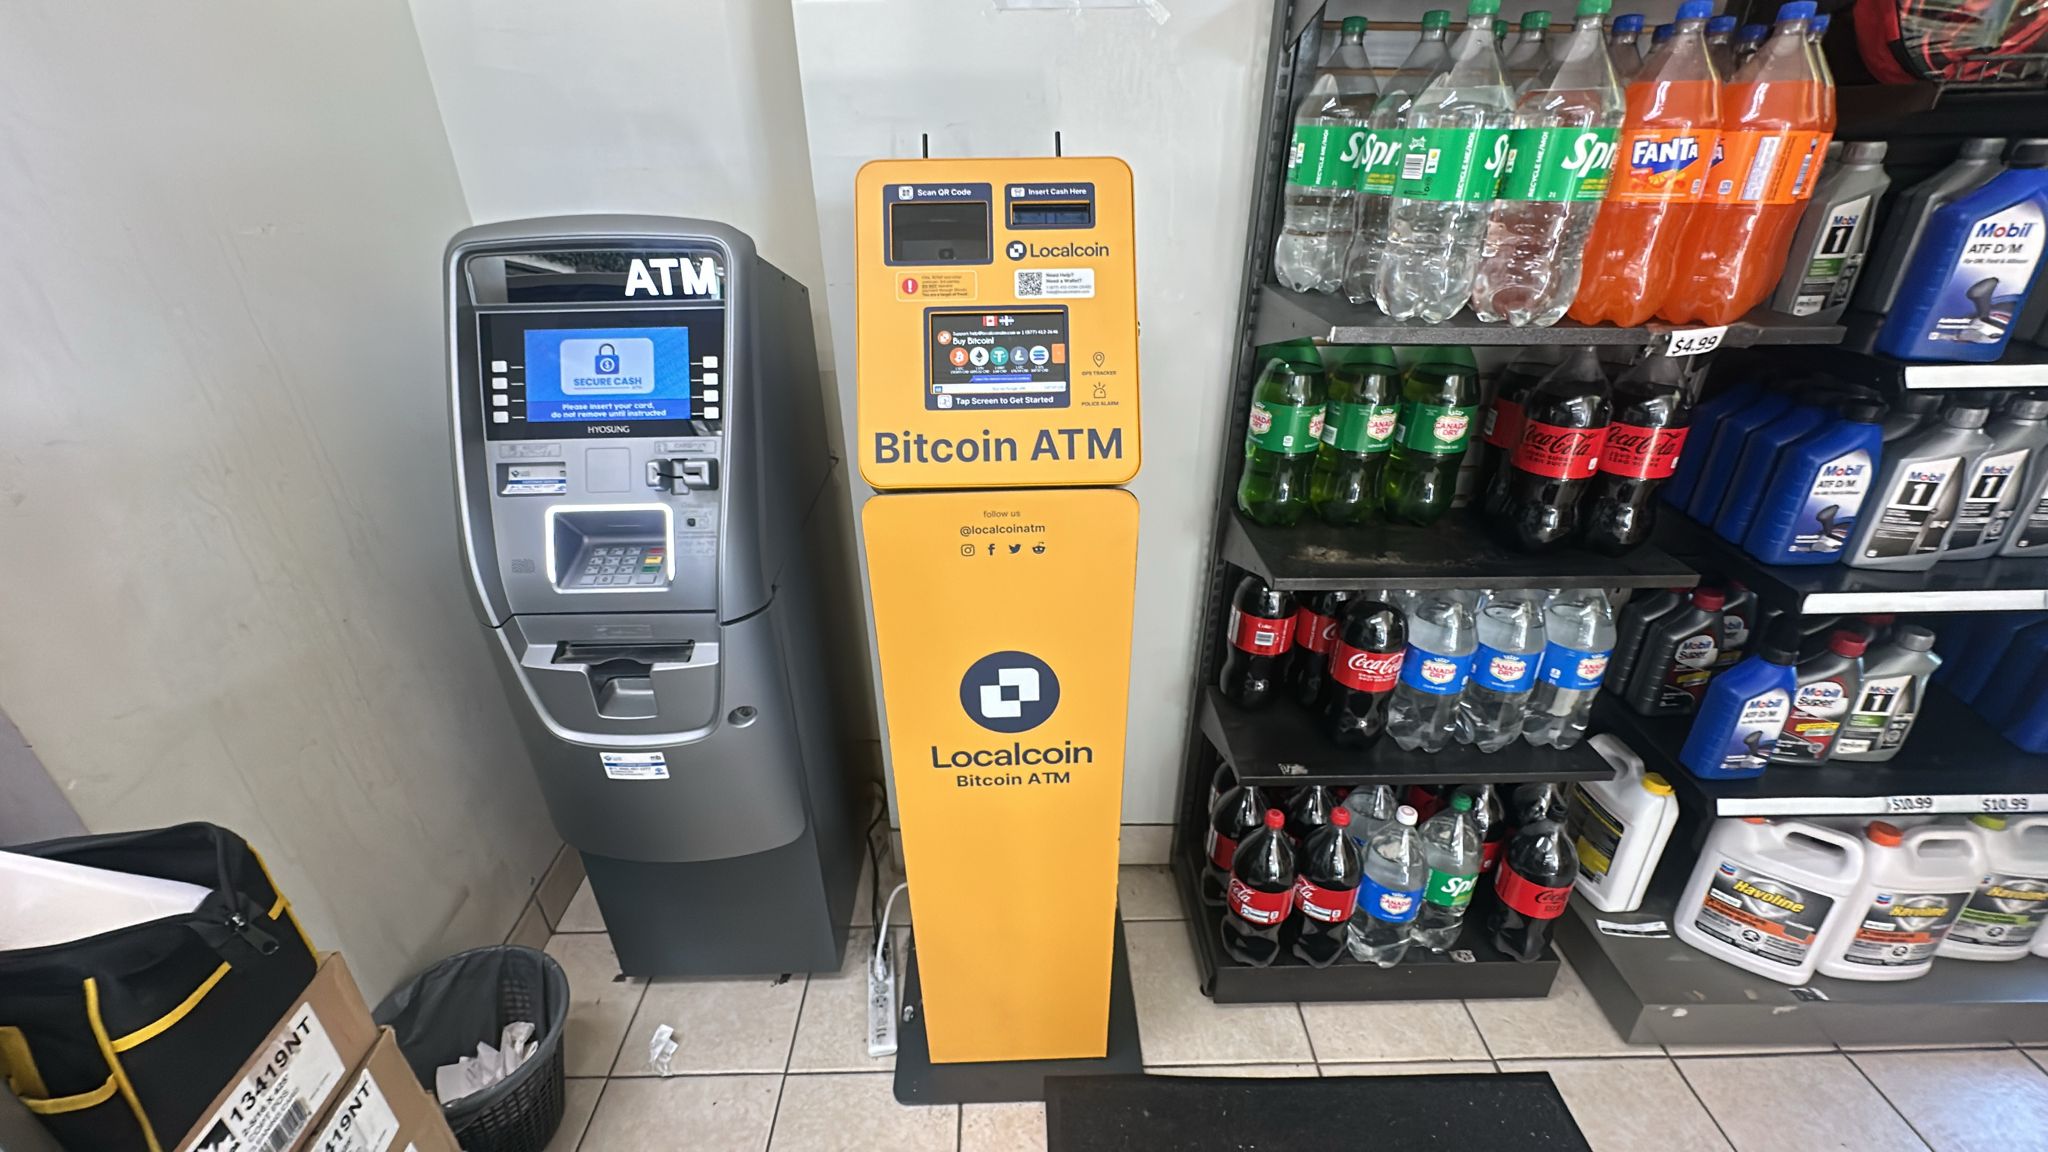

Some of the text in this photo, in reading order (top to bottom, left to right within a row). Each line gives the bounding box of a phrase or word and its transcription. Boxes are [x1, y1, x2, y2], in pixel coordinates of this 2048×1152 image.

[1632, 138, 1698, 164] FANTA
[938, 188, 949, 196] QR
[1832, 215, 1858, 225] Mobil
[1976, 222, 2032, 238] Mobil
[1831, 228, 1845, 252] 1
[1030, 242, 1109, 258] Localcoin
[1968, 244, 1991, 254] ATF
[624, 257, 718, 296] ATM
[953, 338, 966, 346] Buy
[1672, 334, 1718, 354] $4.99
[574, 377, 642, 386] SECURE CASH
[874, 428, 1122, 464] Bitcoin ATM
[1823, 464, 1863, 477] Mobil
[1984, 466, 2012, 474] Mobil
[1908, 472, 1945, 482] Mobil
[1817, 480, 1835, 488] ATF
[1983, 477, 2000, 497] 1
[1910, 484, 1929, 504] 1
[960, 524, 1046, 537] @localcoinatm
[1684, 641, 1712, 650] Mobil
[1679, 650, 1708, 660] Super
[1422, 664, 1456, 677] CANADA
[1490, 662, 1526, 674] CANADA
[1498, 668, 1514, 677] DRY
[1585, 668, 1600, 676] DRY
[1803, 688, 1841, 697] Mobil
[1748, 699, 1783, 709] Mobil
[1798, 697, 1835, 708] Super
[1871, 695, 1884, 711] 1
[931, 741, 1093, 768] Localcoin
[956, 772, 1070, 787] Bitcoin ATM
[1893, 797, 1933, 810] $10.99
[1982, 798, 2028, 811] $10.99
[1733, 880, 1805, 912] Havoline
[230, 1016, 310, 1122] 13419NT
